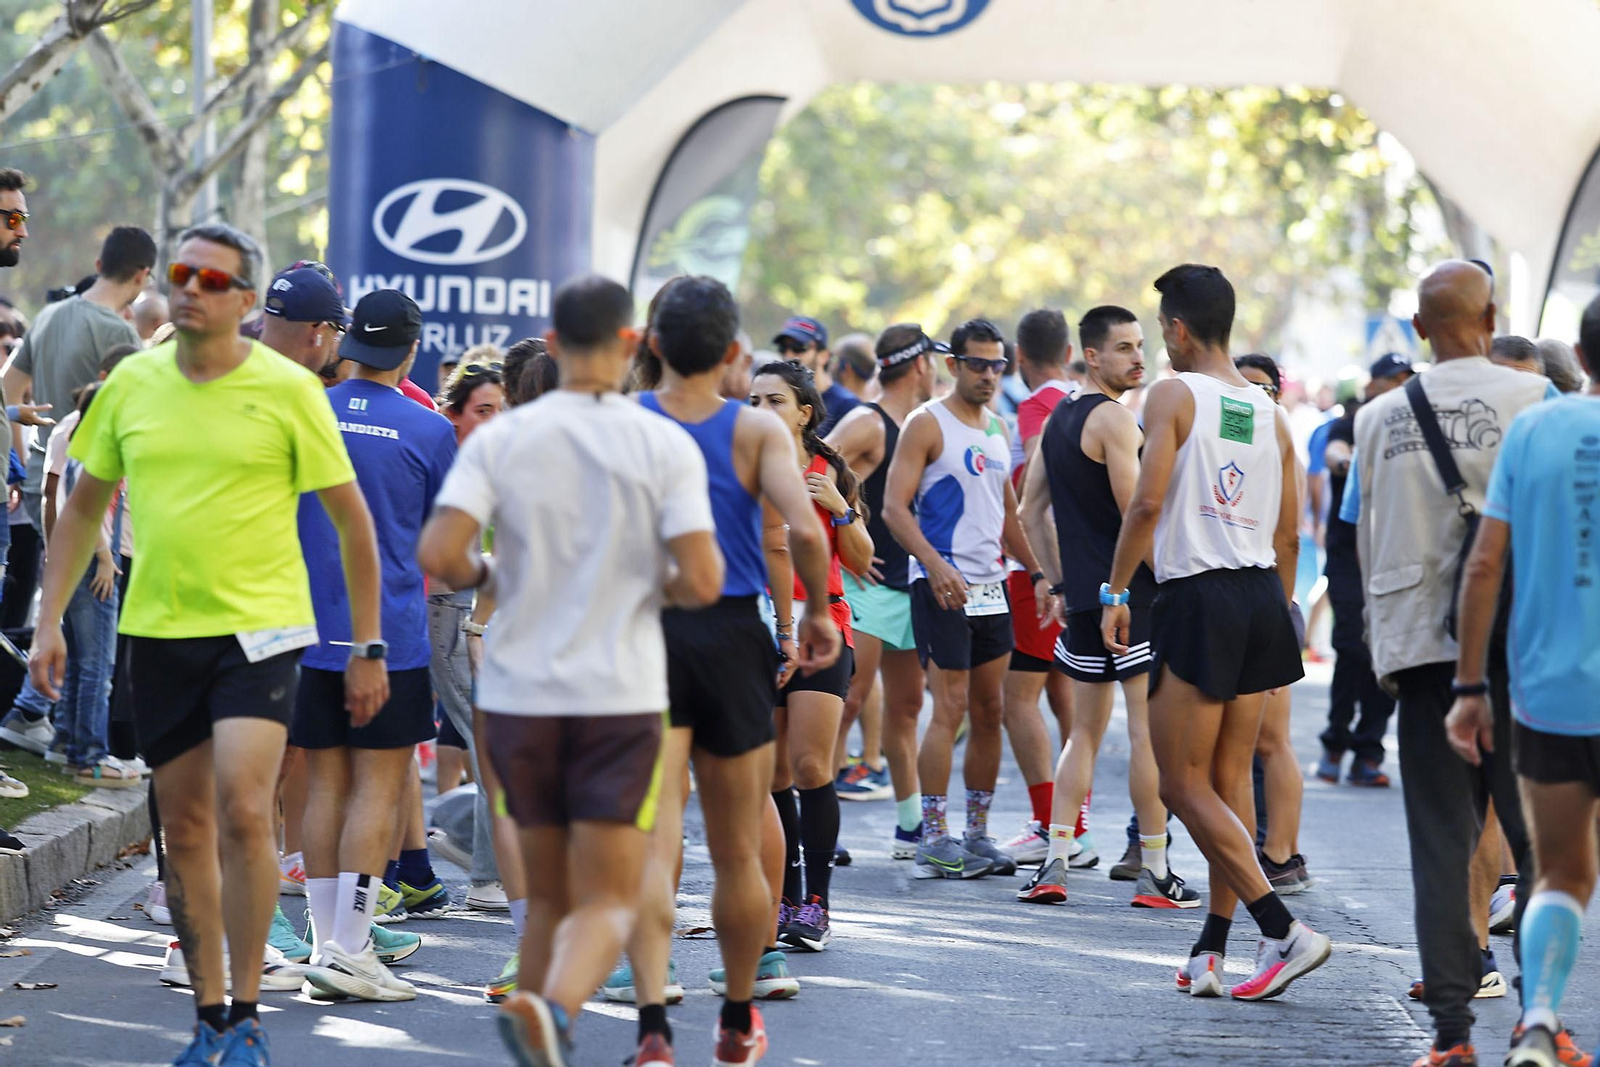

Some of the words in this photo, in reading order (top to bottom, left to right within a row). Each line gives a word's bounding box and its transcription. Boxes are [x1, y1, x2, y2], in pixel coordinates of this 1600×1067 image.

[420, 321, 512, 355] RLUZ
[337, 421, 399, 440] ANDIETA
[353, 889, 368, 914] NIKE
